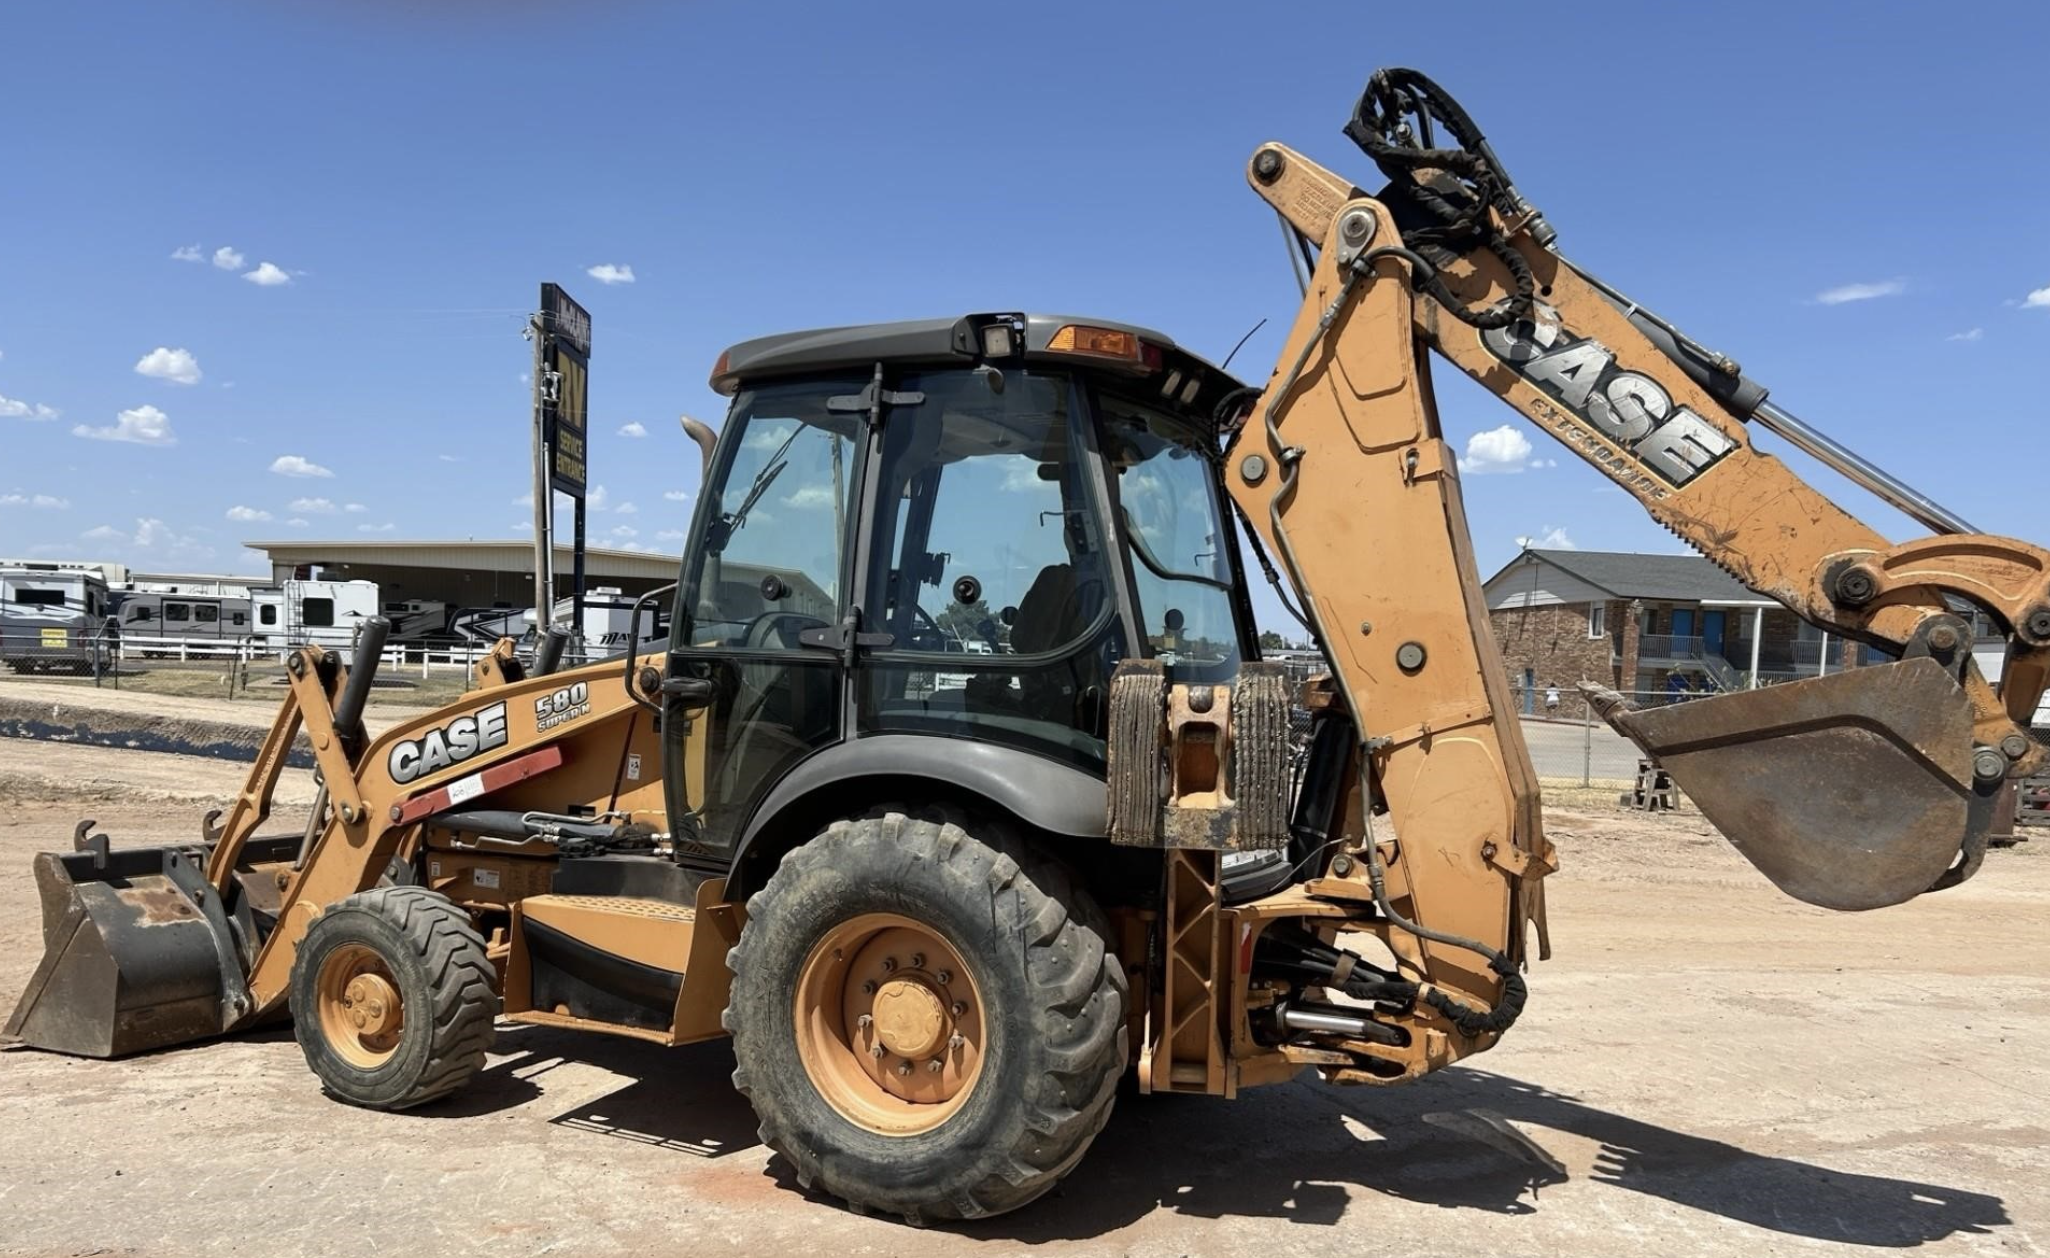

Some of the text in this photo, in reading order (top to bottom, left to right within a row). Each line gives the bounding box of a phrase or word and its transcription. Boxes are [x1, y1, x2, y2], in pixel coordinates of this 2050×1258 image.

[558, 351, 586, 429] RV
[1481, 299, 1738, 485] CASE
[560, 429, 583, 460] SERVICE
[556, 452, 586, 484] ENTRANCE
[535, 681, 588, 720] 580
[537, 702, 591, 733] SUPER N
[388, 701, 508, 784] CASE
